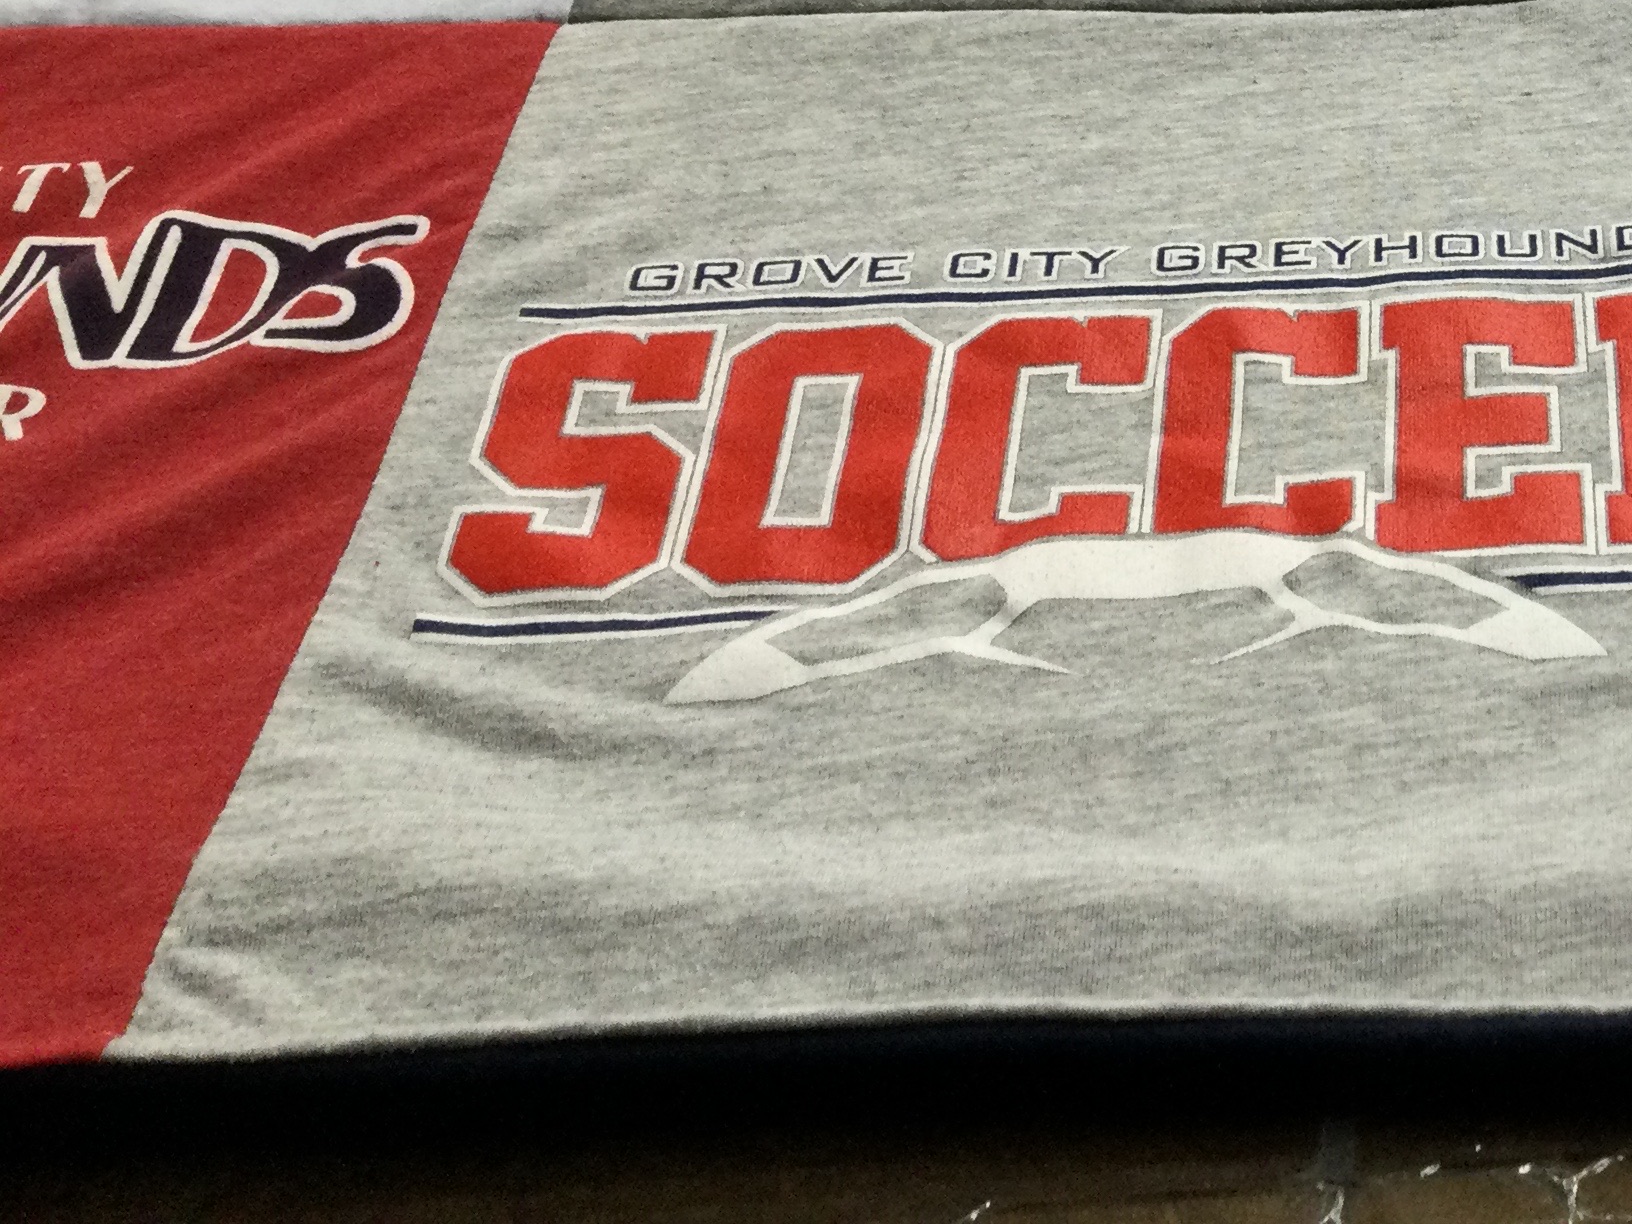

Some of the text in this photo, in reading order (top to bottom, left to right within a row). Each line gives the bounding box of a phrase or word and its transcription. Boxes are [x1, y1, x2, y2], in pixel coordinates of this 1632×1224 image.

[0, 209, 431, 370] NDS
[626, 252, 914, 293] GROVE
[944, 241, 1124, 286] CITY
